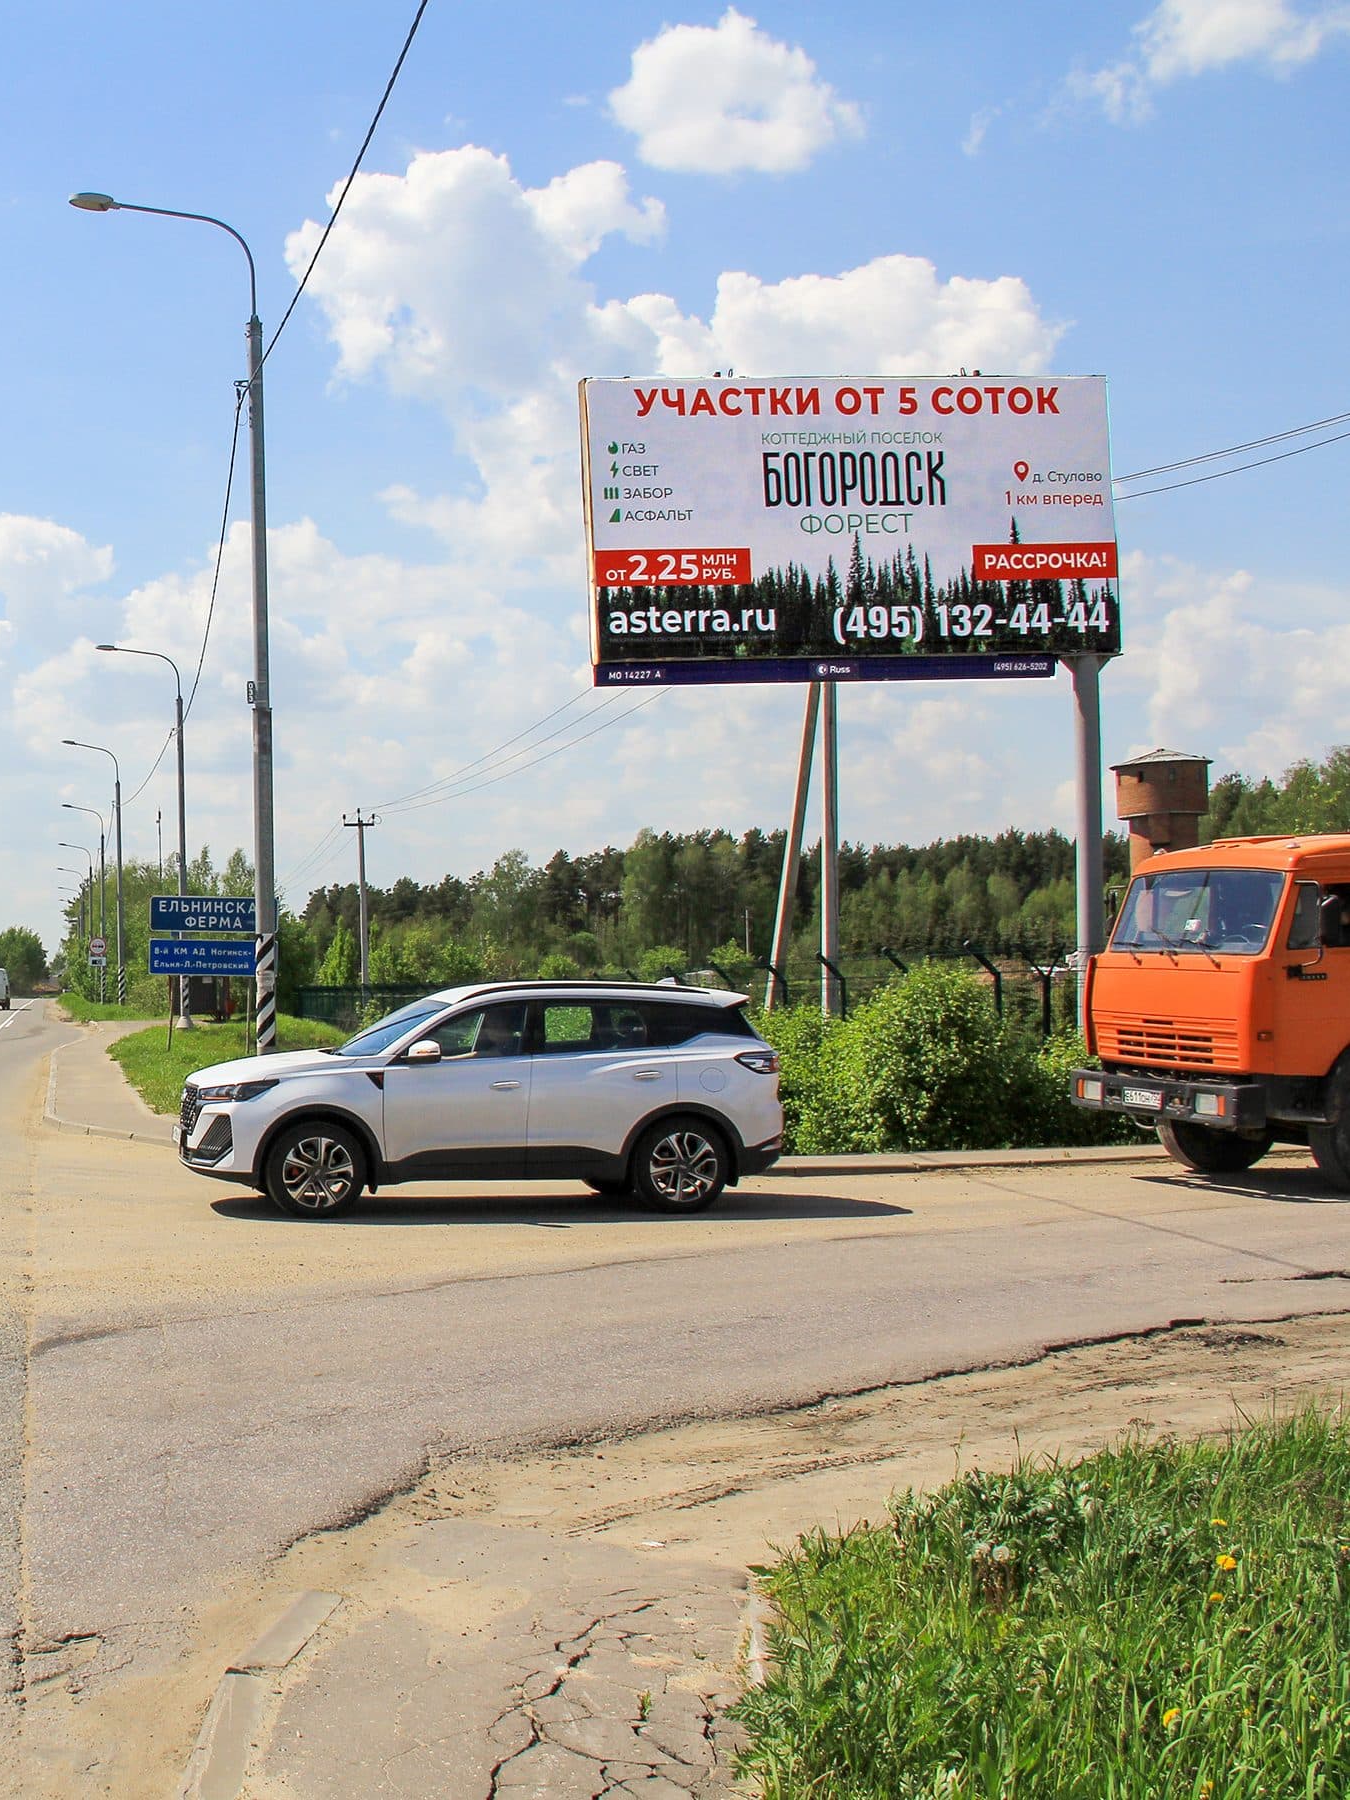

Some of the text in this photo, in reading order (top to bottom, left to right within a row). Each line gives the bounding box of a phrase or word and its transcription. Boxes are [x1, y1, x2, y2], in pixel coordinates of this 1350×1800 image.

[634, 387, 1060, 417] УЧАСТКИ ОТ 5 СОТОК
[761, 430, 943, 446] КОТТЕДЖНЫЙ ПОСЕЛОК
[621, 443, 646, 454] ГАЗ
[622, 465, 659, 477] СВЕТ
[1032, 471, 1102, 484] д. Стулово
[762, 451, 946, 507] БОГОРОДСК
[623, 487, 673, 499] ЗАБОР
[1005, 490, 1104, 507] 1 км вперед
[624, 510, 693, 521] АСФАЛЬТ
[800, 513, 913, 534] ФОРЕСТ
[984, 552, 1107, 570] РАССРОЧКА!
[628, 554, 699, 583] 2,25
[701, 554, 737, 566] МЛН
[702, 568, 736, 580] РУБ.
[609, 606, 777, 634] asterra.ru
[833, 601, 1110, 645] (495) 132-44-44
[624, 670, 651, 680] 14227
[829, 665, 851, 674] Russ
[158, 900, 256, 914] ЕЛЬНИНСКА
[185, 916, 243, 929] ФЕРМА
[173, 947, 188, 955] КМ
[192, 947, 206, 956] АД
[210, 948, 252, 958] Ногинск-
